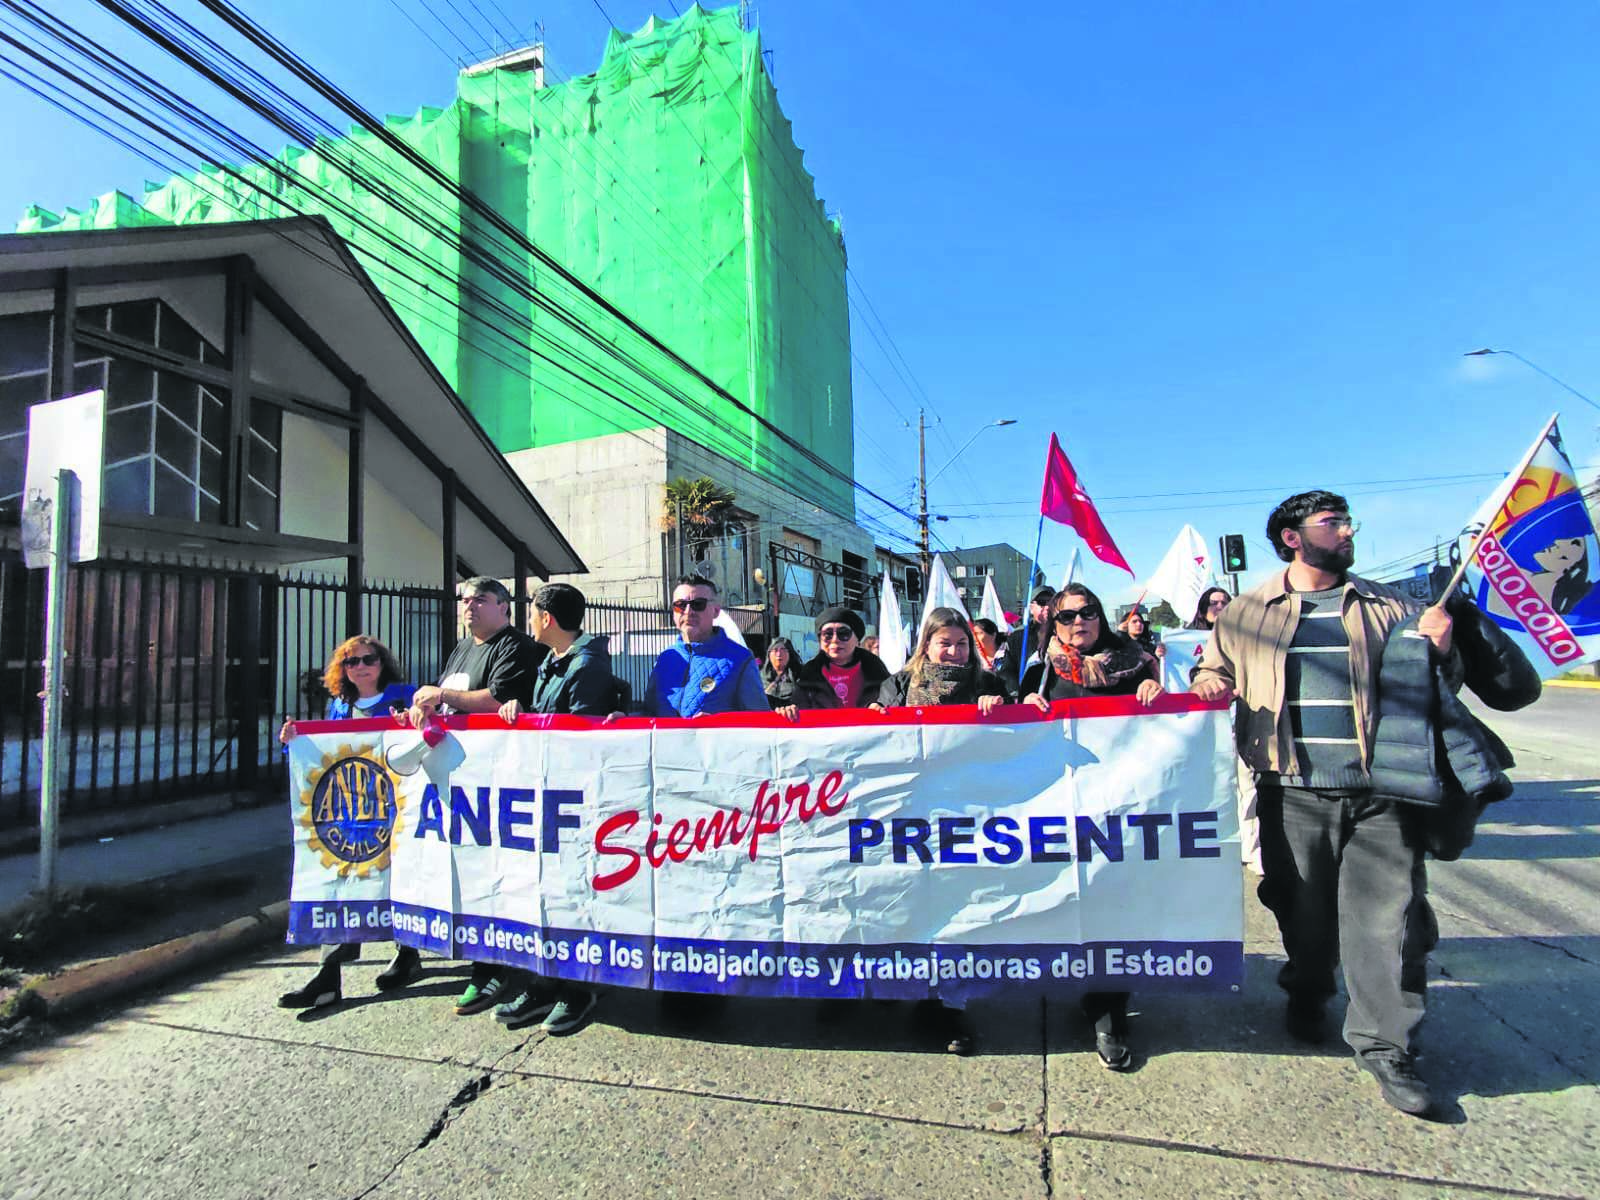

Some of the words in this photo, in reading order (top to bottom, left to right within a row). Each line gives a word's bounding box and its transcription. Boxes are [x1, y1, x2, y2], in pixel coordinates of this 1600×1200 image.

[327, 826, 390, 857] CHILE
[414, 783, 584, 854] ANEF
[592, 770, 849, 891] Siempre
[848, 811, 1222, 864] PRESENTE
[312, 906, 336, 928] En
[343, 906, 361, 928] la
[430, 914, 449, 941] de
[484, 922, 570, 961] derechos
[575, 936, 603, 965] de
[609, 939, 644, 970] los
[651, 943, 820, 983] trabajadores
[827, 957, 845, 986] y
[853, 950, 1042, 987] trabajadoras
[1051, 949, 1095, 978] del
[1105, 948, 1214, 976] Estado
